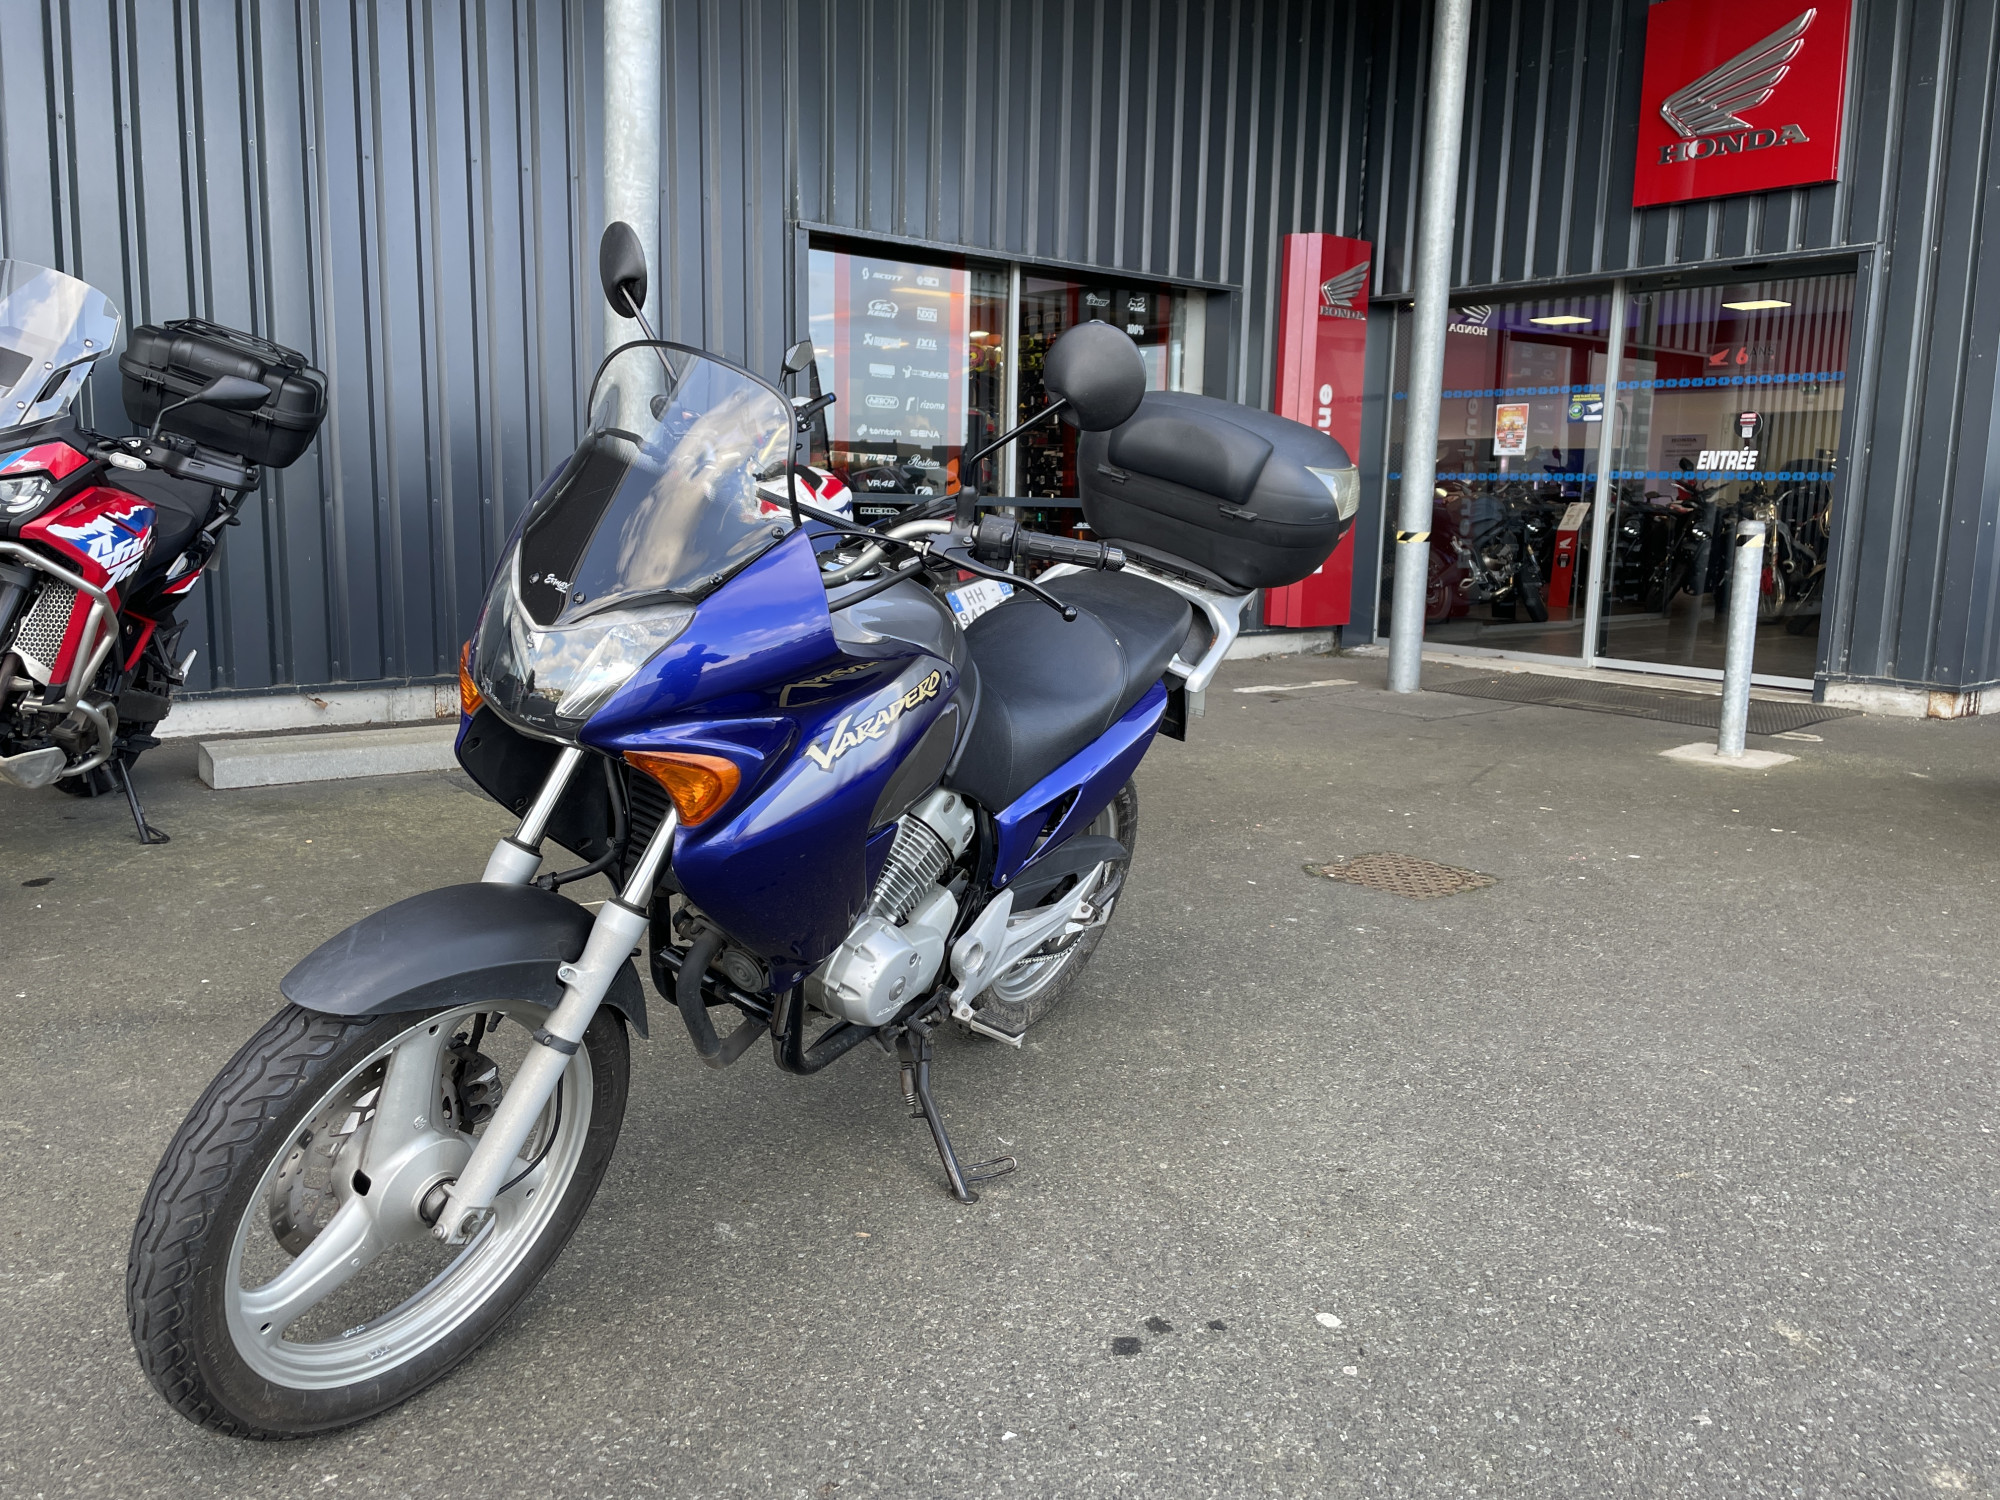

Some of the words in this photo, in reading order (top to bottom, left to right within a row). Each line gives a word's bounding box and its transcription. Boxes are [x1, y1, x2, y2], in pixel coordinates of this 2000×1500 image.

[1657, 124, 1809, 165] HONDA
[872, 272, 904, 282] SCOTT
[867, 309, 898, 319] KENNY
[1319, 305, 1367, 321] HONDA
[1126, 323, 1145, 335] 100%
[915, 338, 938, 350] IXIL
[1735, 346, 1749, 365] 6
[868, 396, 897, 407] ARROW
[920, 400, 946, 410] rizoma
[869, 427, 902, 437] tomtom
[909, 429, 941, 438] SENA
[907, 453, 940, 470] Restom
[1696, 445, 1759, 471] ENTRÉE
[860, 507, 900, 515] RICHA
[1001, 584, 1011, 593] 22
[964, 587, 986, 606] HH
[804, 668, 943, 773] VARADERO
